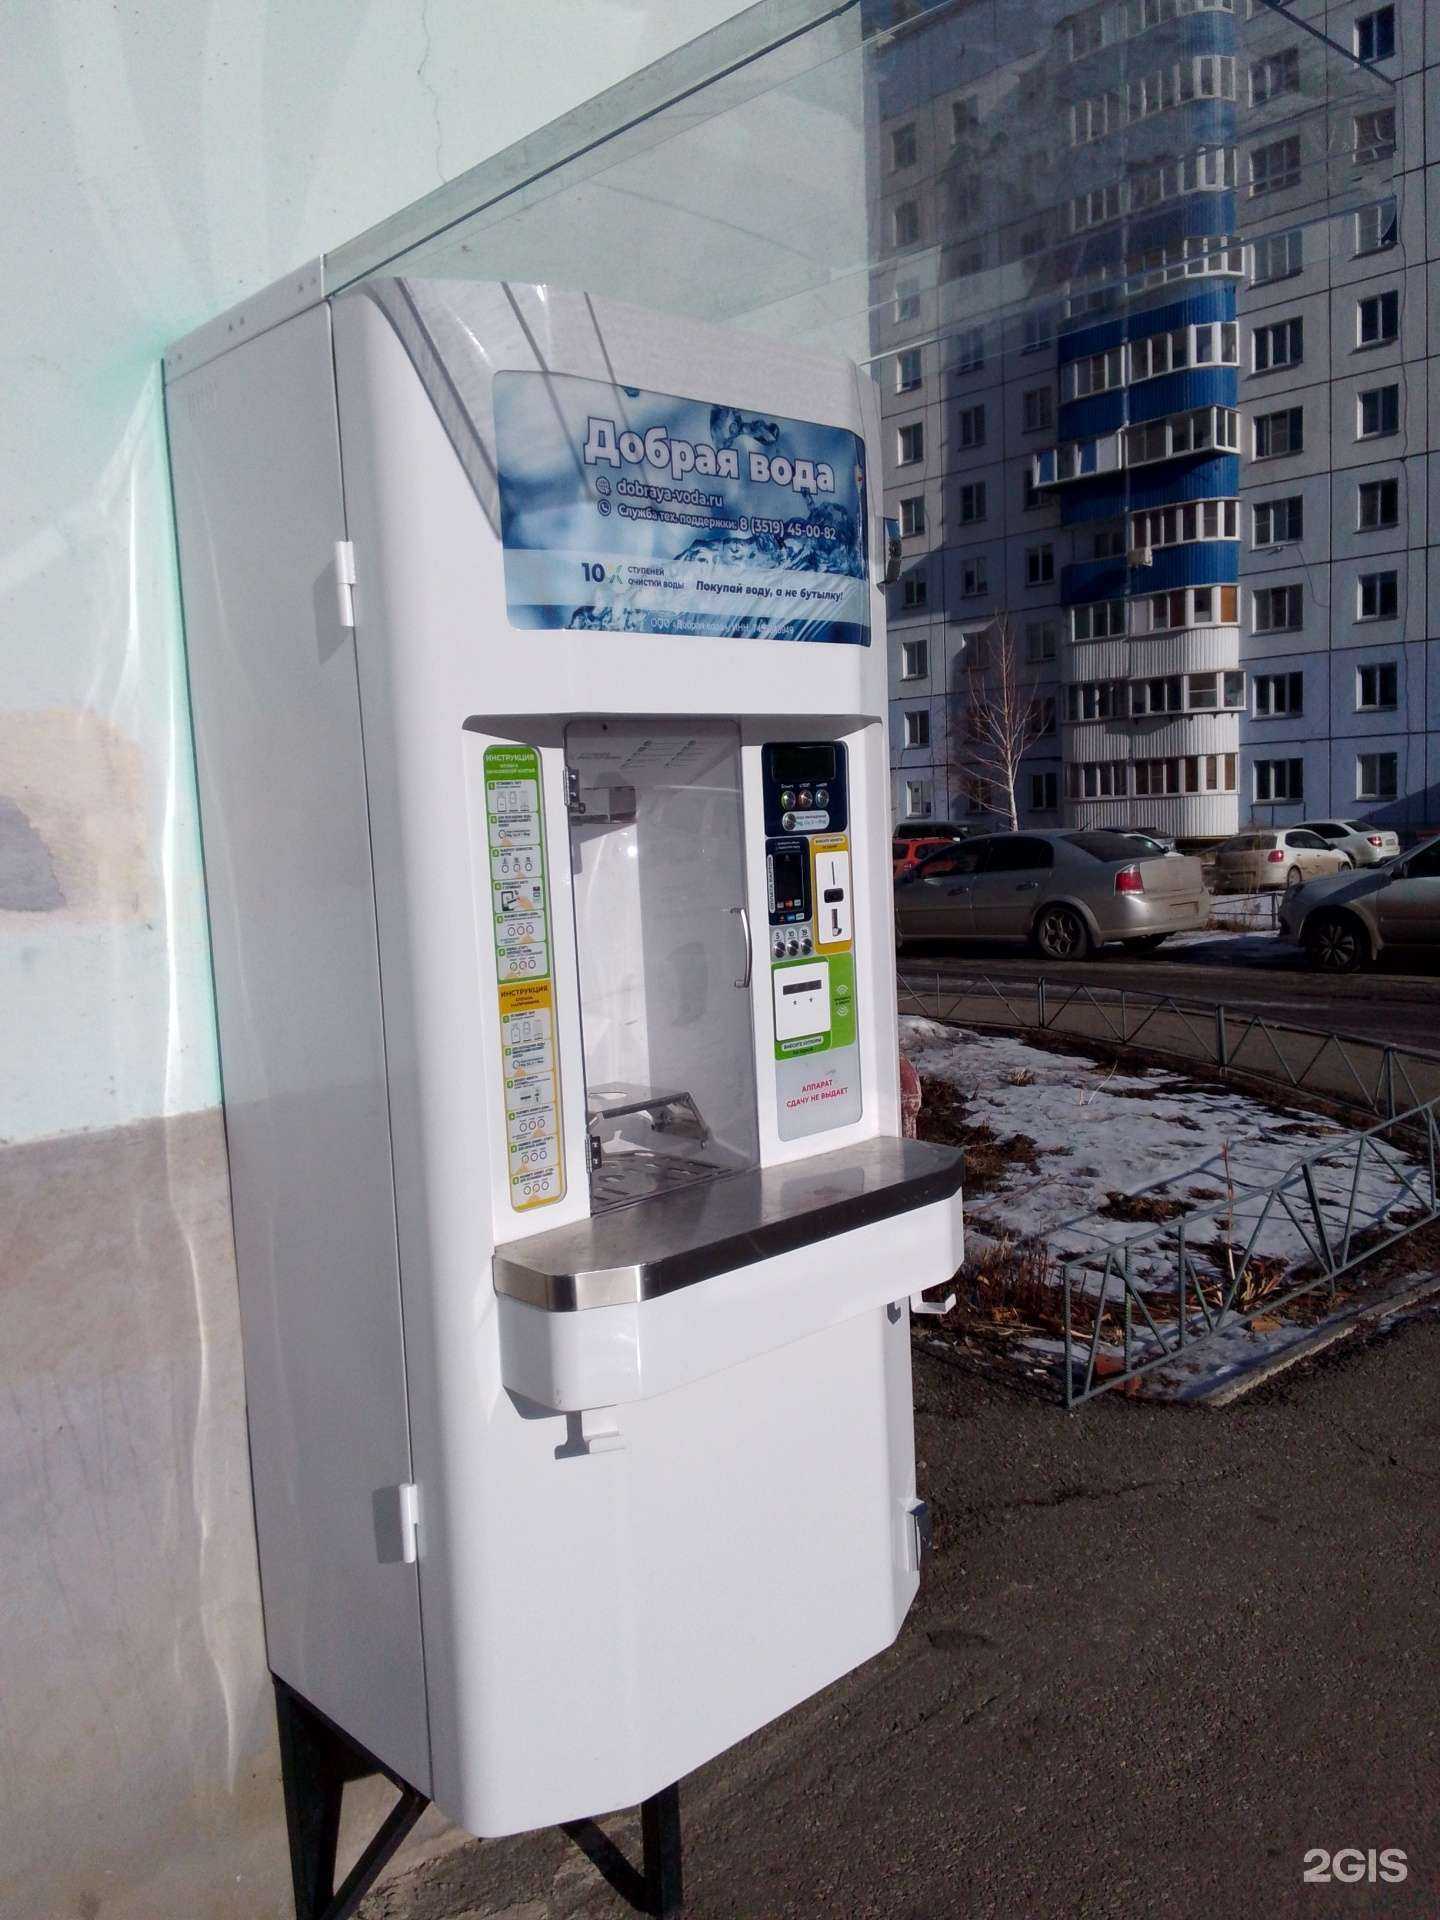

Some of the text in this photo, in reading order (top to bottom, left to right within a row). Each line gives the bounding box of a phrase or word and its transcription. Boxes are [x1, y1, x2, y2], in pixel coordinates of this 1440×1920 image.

[583, 416, 836, 495] Добрая вода
[618, 479, 723, 506] dobraya-voda.ru
[618, 503, 659, 521] Служба
[680, 513, 738, 531] поддержки:
[740, 516, 749, 531] 8
[751, 517, 784, 537] (3519)
[787, 523, 837, 540] 45-00-82
[581, 562, 606, 582] 10
[695, 580, 843, 603] Покупай воду, а не бутылку!
[786, 1086, 849, 1108] СДАЧУ НЕ ВЫДАЕТ
[802, 1079, 833, 1092] АППАРАТ
